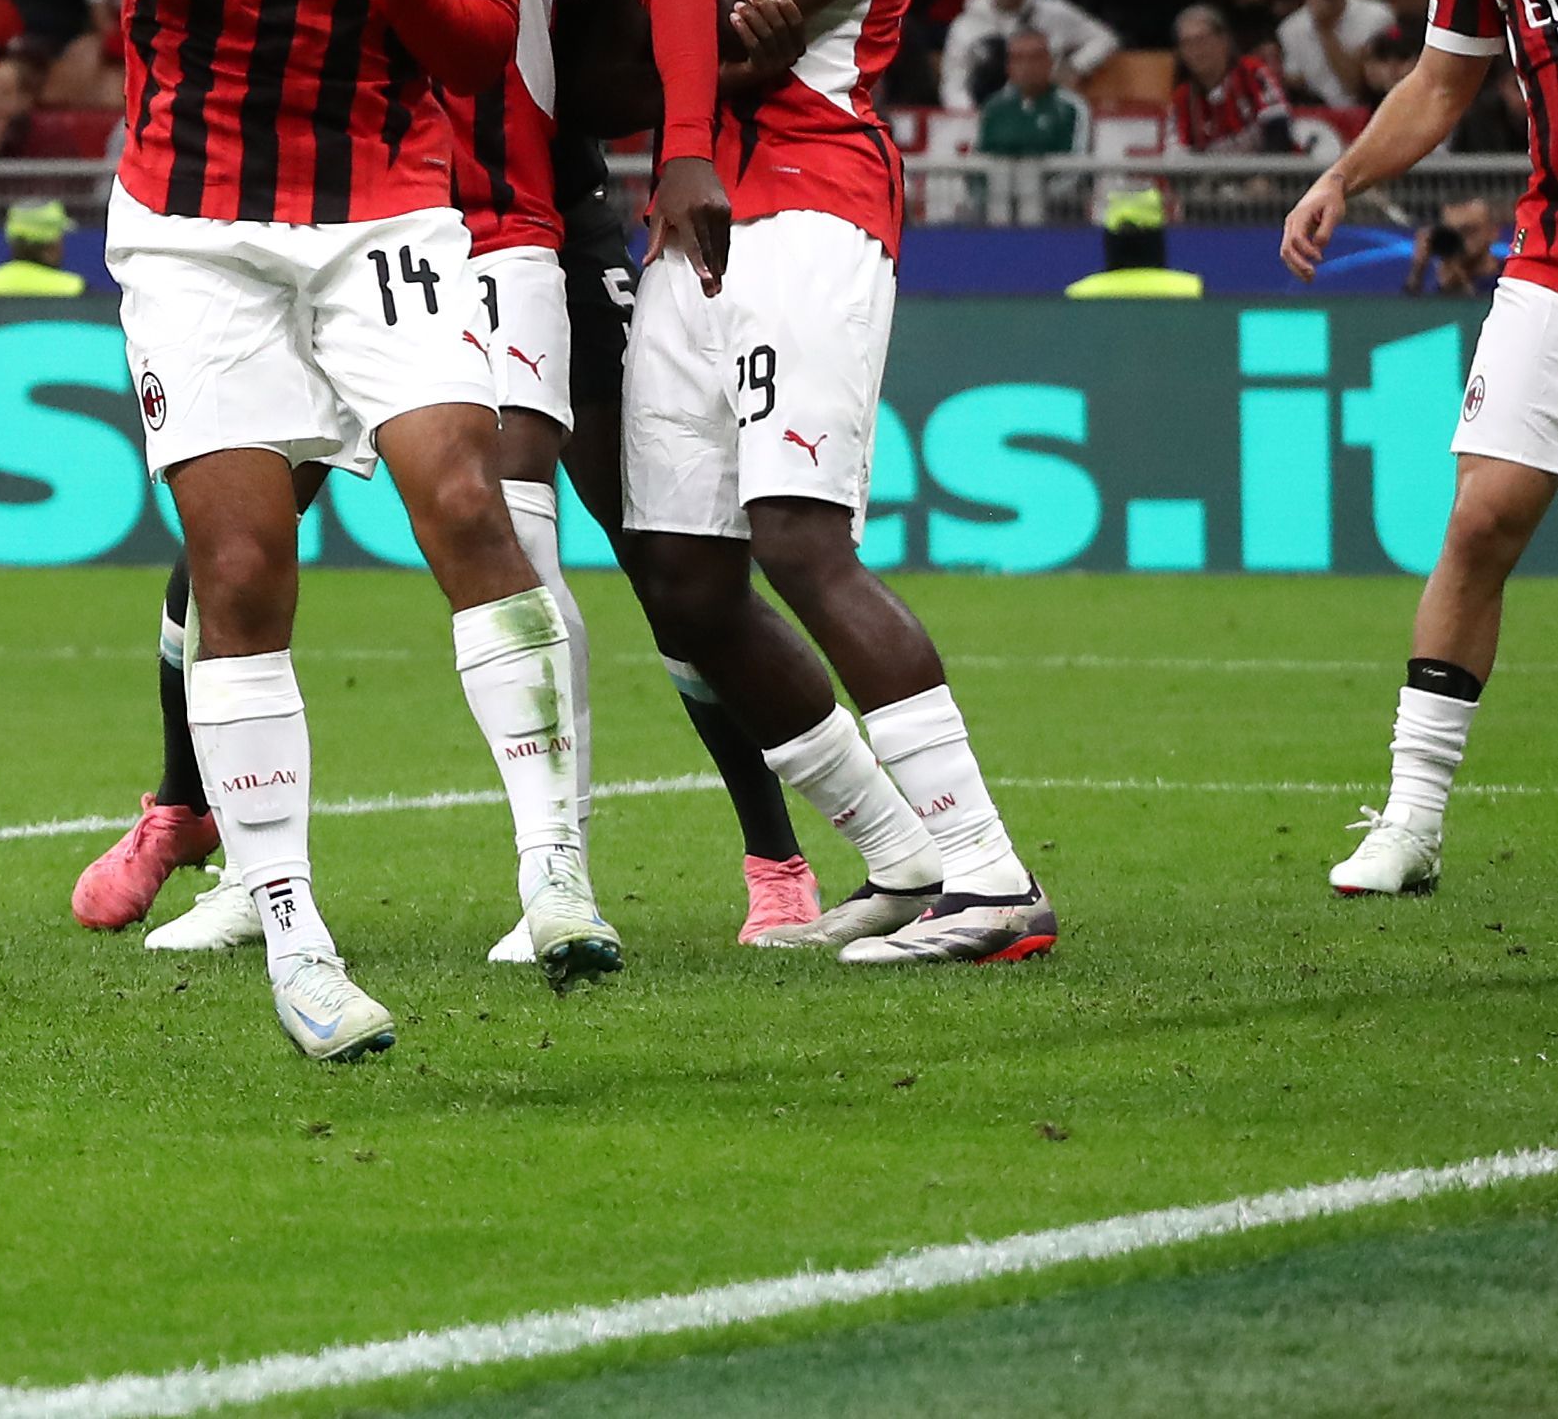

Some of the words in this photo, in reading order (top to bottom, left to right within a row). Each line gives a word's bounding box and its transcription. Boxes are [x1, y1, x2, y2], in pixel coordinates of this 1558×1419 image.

[366, 245, 440, 326] 14
[504, 735, 572, 761] MILAN
[221, 769, 298, 794] MILAN
